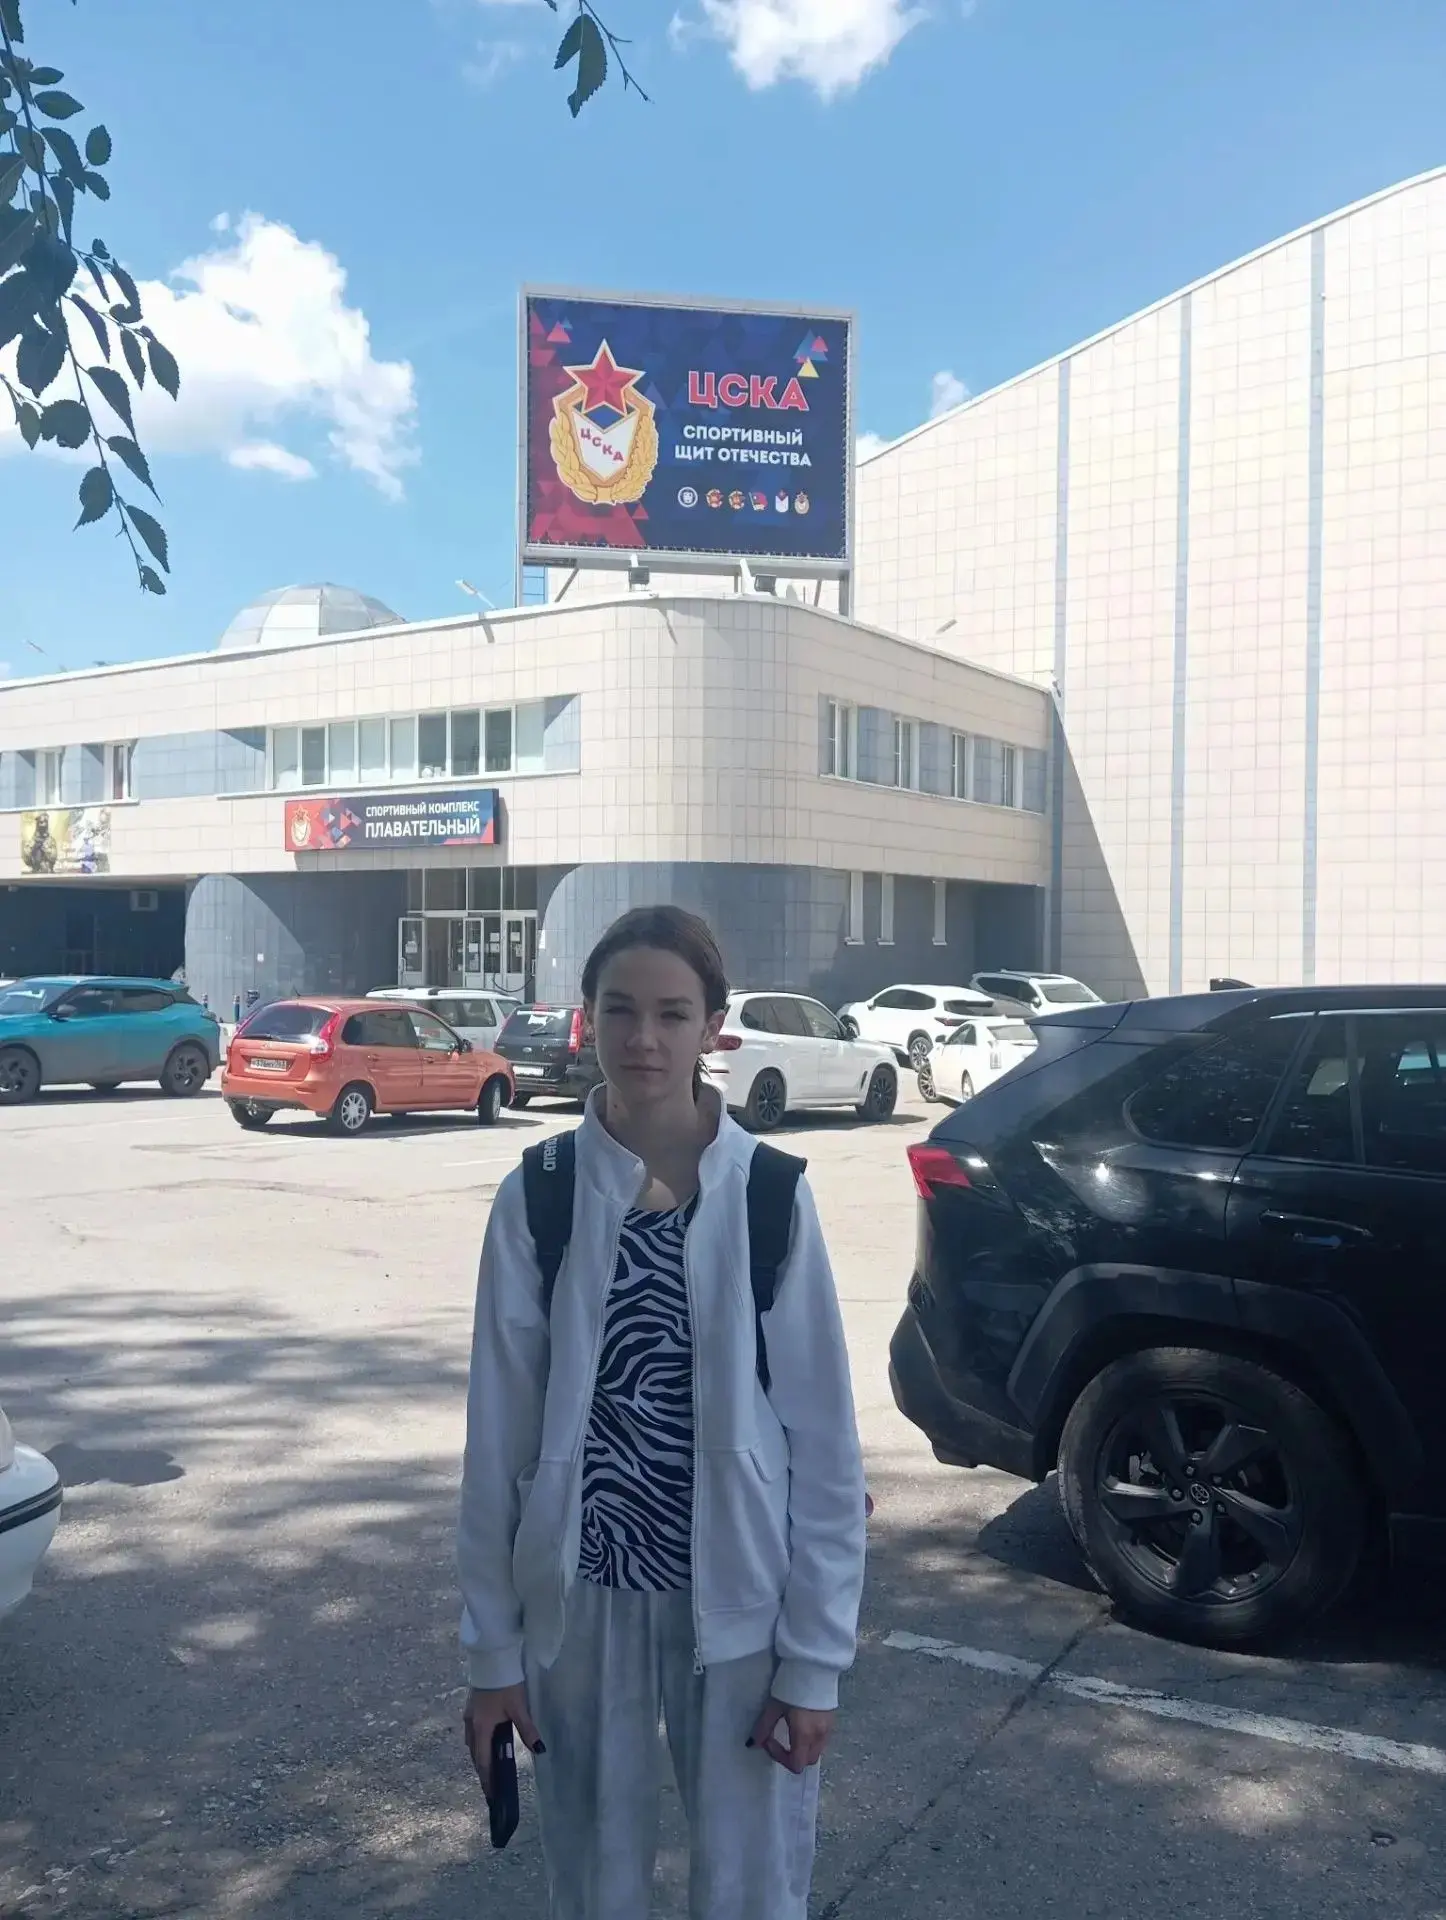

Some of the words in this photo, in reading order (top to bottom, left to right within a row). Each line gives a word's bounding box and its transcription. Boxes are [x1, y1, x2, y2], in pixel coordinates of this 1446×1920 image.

[688, 370, 810, 412] ЦСКА
[580, 427, 624, 463] ЦСКА
[683, 424, 803, 446] СПОРТИВНЫЙ
[674, 444, 714, 462] ЩИТ
[718, 447, 812, 467] ОТЕЧЕСТВА
[365, 803, 426, 817] СПОРТИВНЫЙ
[428, 800, 480, 814] КОМПЛЕКС
[365, 815, 481, 838] ПЛАВАТЕЛЬНЫЙ
[542, 1137, 558, 1171] arena
